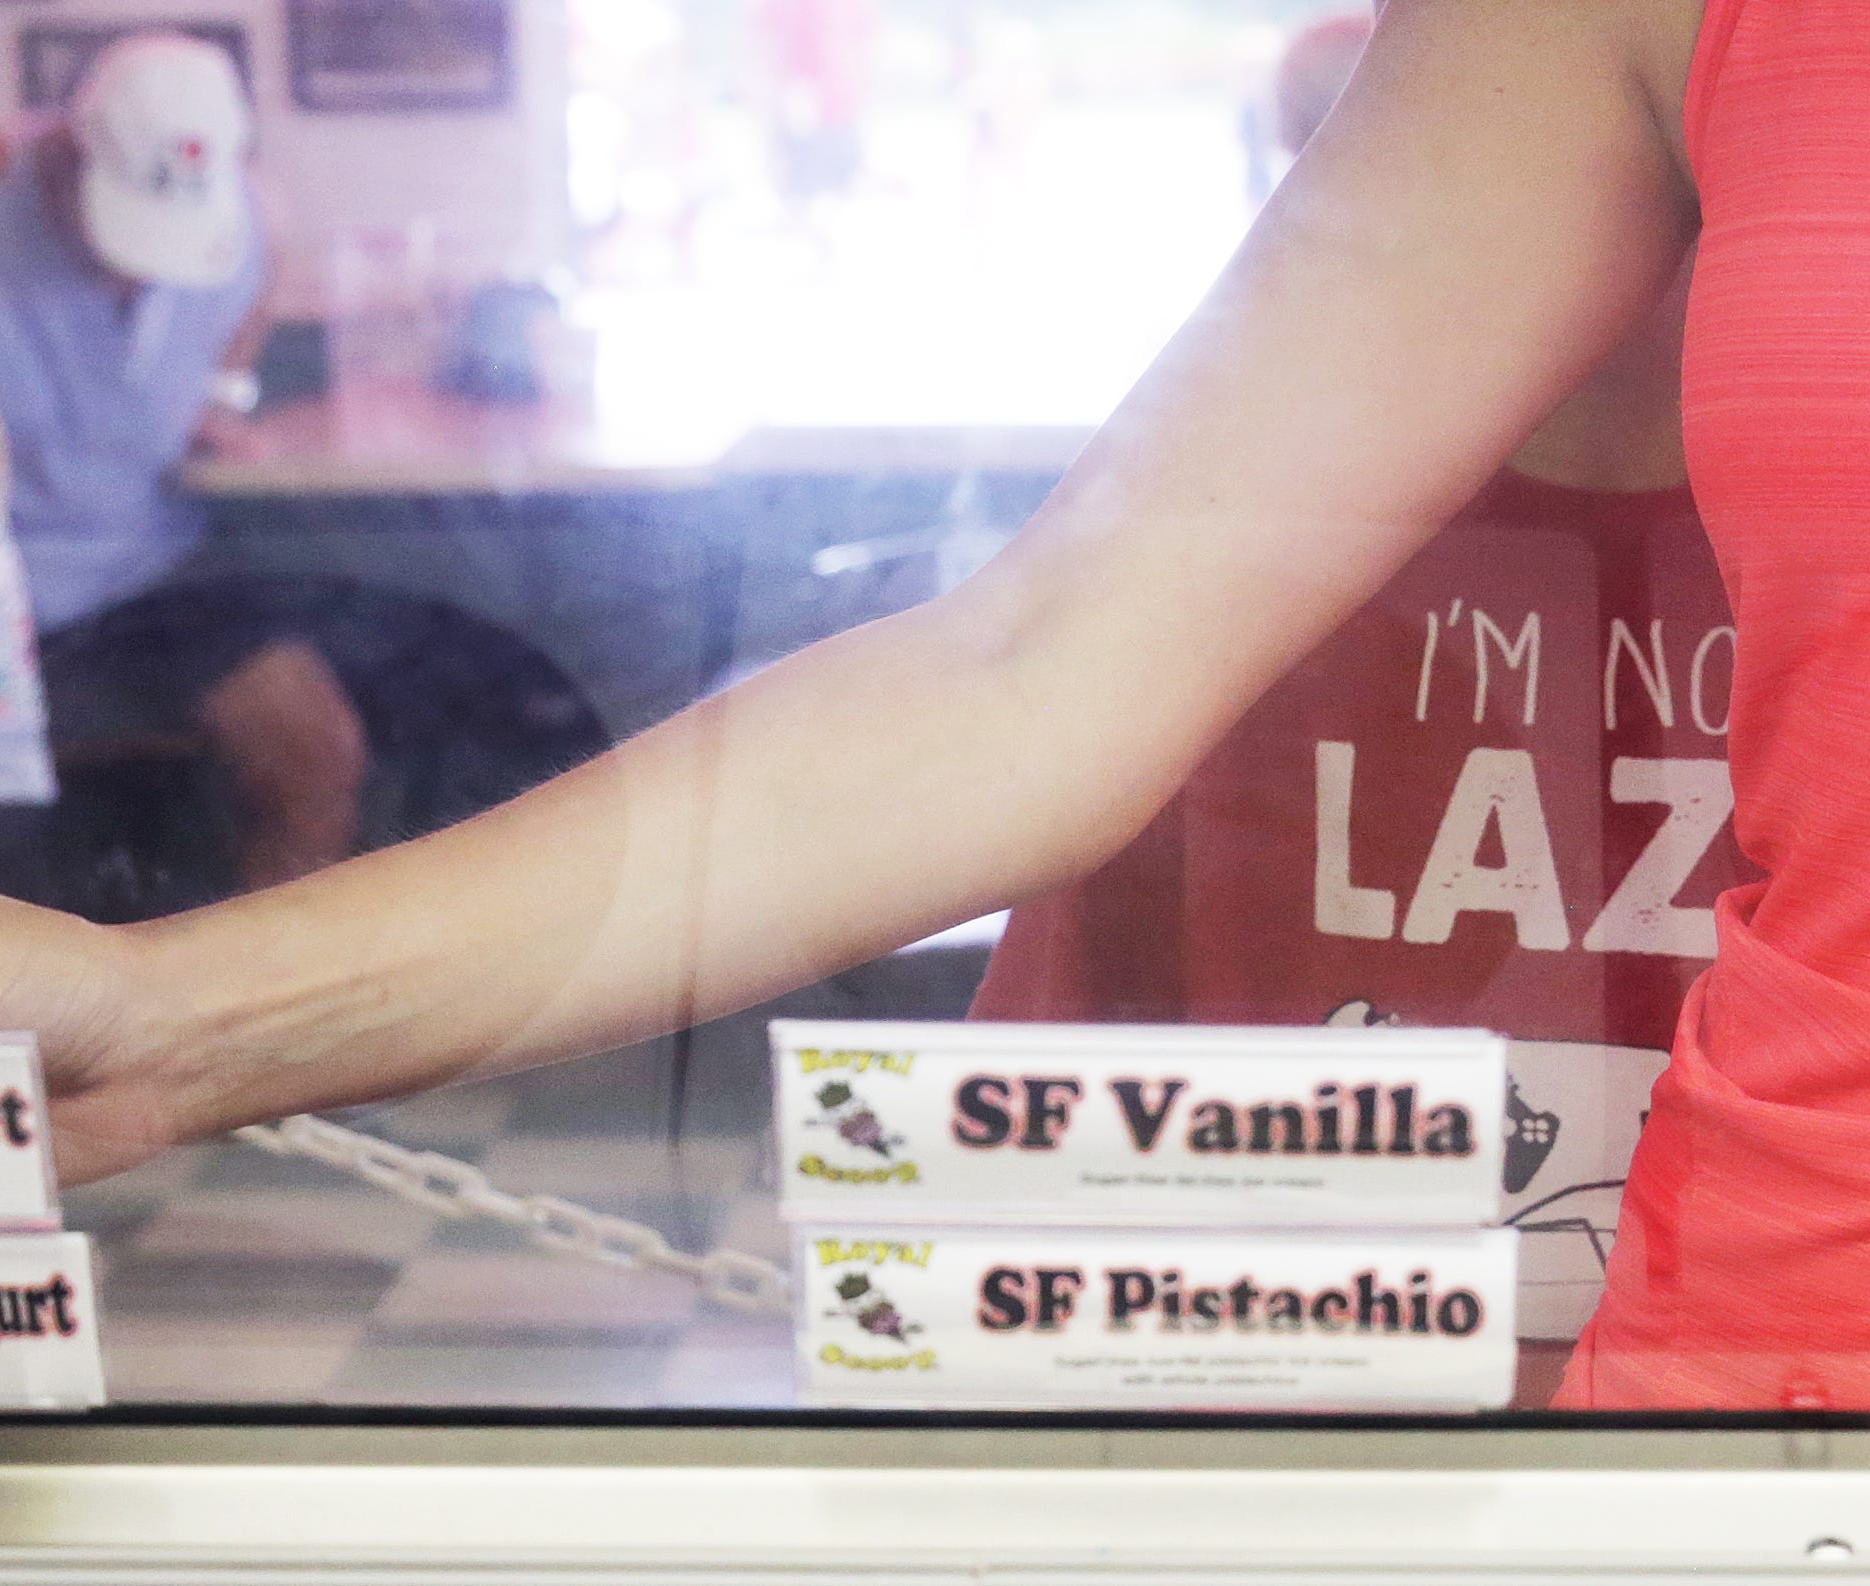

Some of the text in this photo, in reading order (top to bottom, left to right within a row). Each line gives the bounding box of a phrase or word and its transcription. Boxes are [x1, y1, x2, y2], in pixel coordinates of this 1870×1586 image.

[1415, 599, 1539, 724] I'M
[952, 1076, 1476, 1158] SF Vanilla
[976, 1264, 1485, 1338] SF Pistachio
